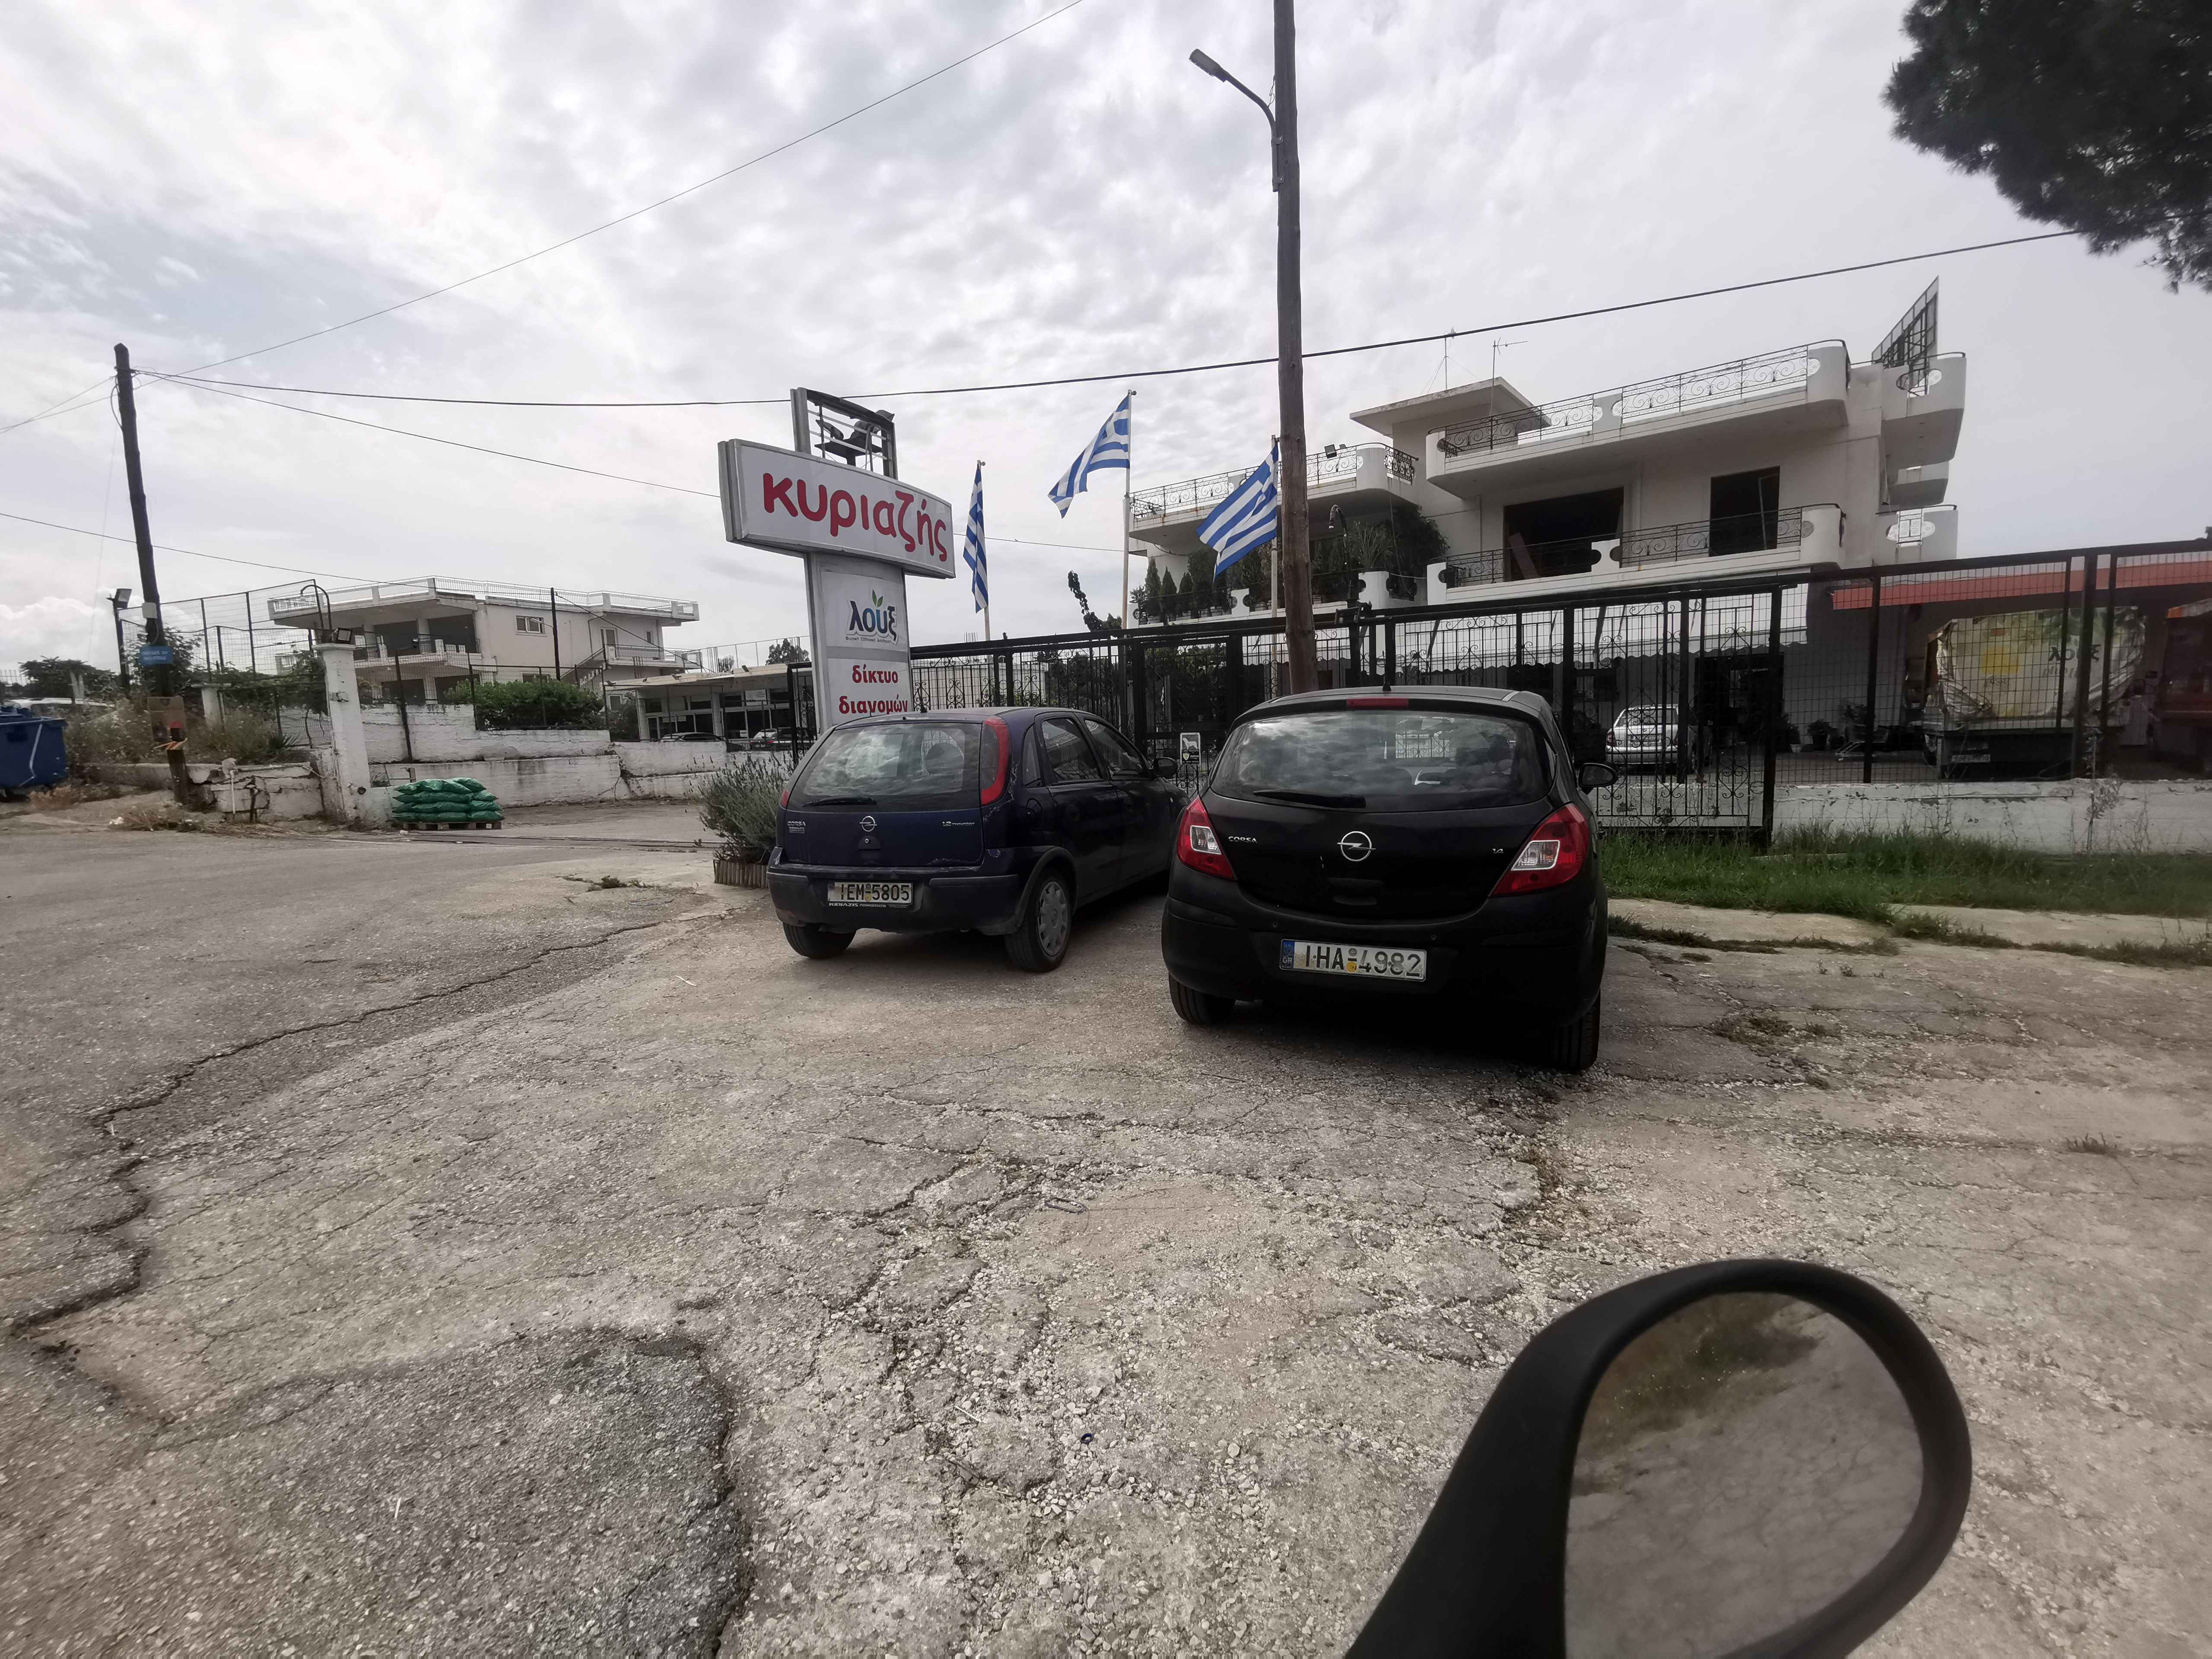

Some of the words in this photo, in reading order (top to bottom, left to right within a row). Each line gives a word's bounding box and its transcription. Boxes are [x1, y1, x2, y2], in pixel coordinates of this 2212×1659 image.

[763, 473, 947, 562] κυριαζής
[849, 601, 897, 641] λουξ
[852, 664, 898, 683] δίκτυο
[839, 694, 908, 714] διανομών
